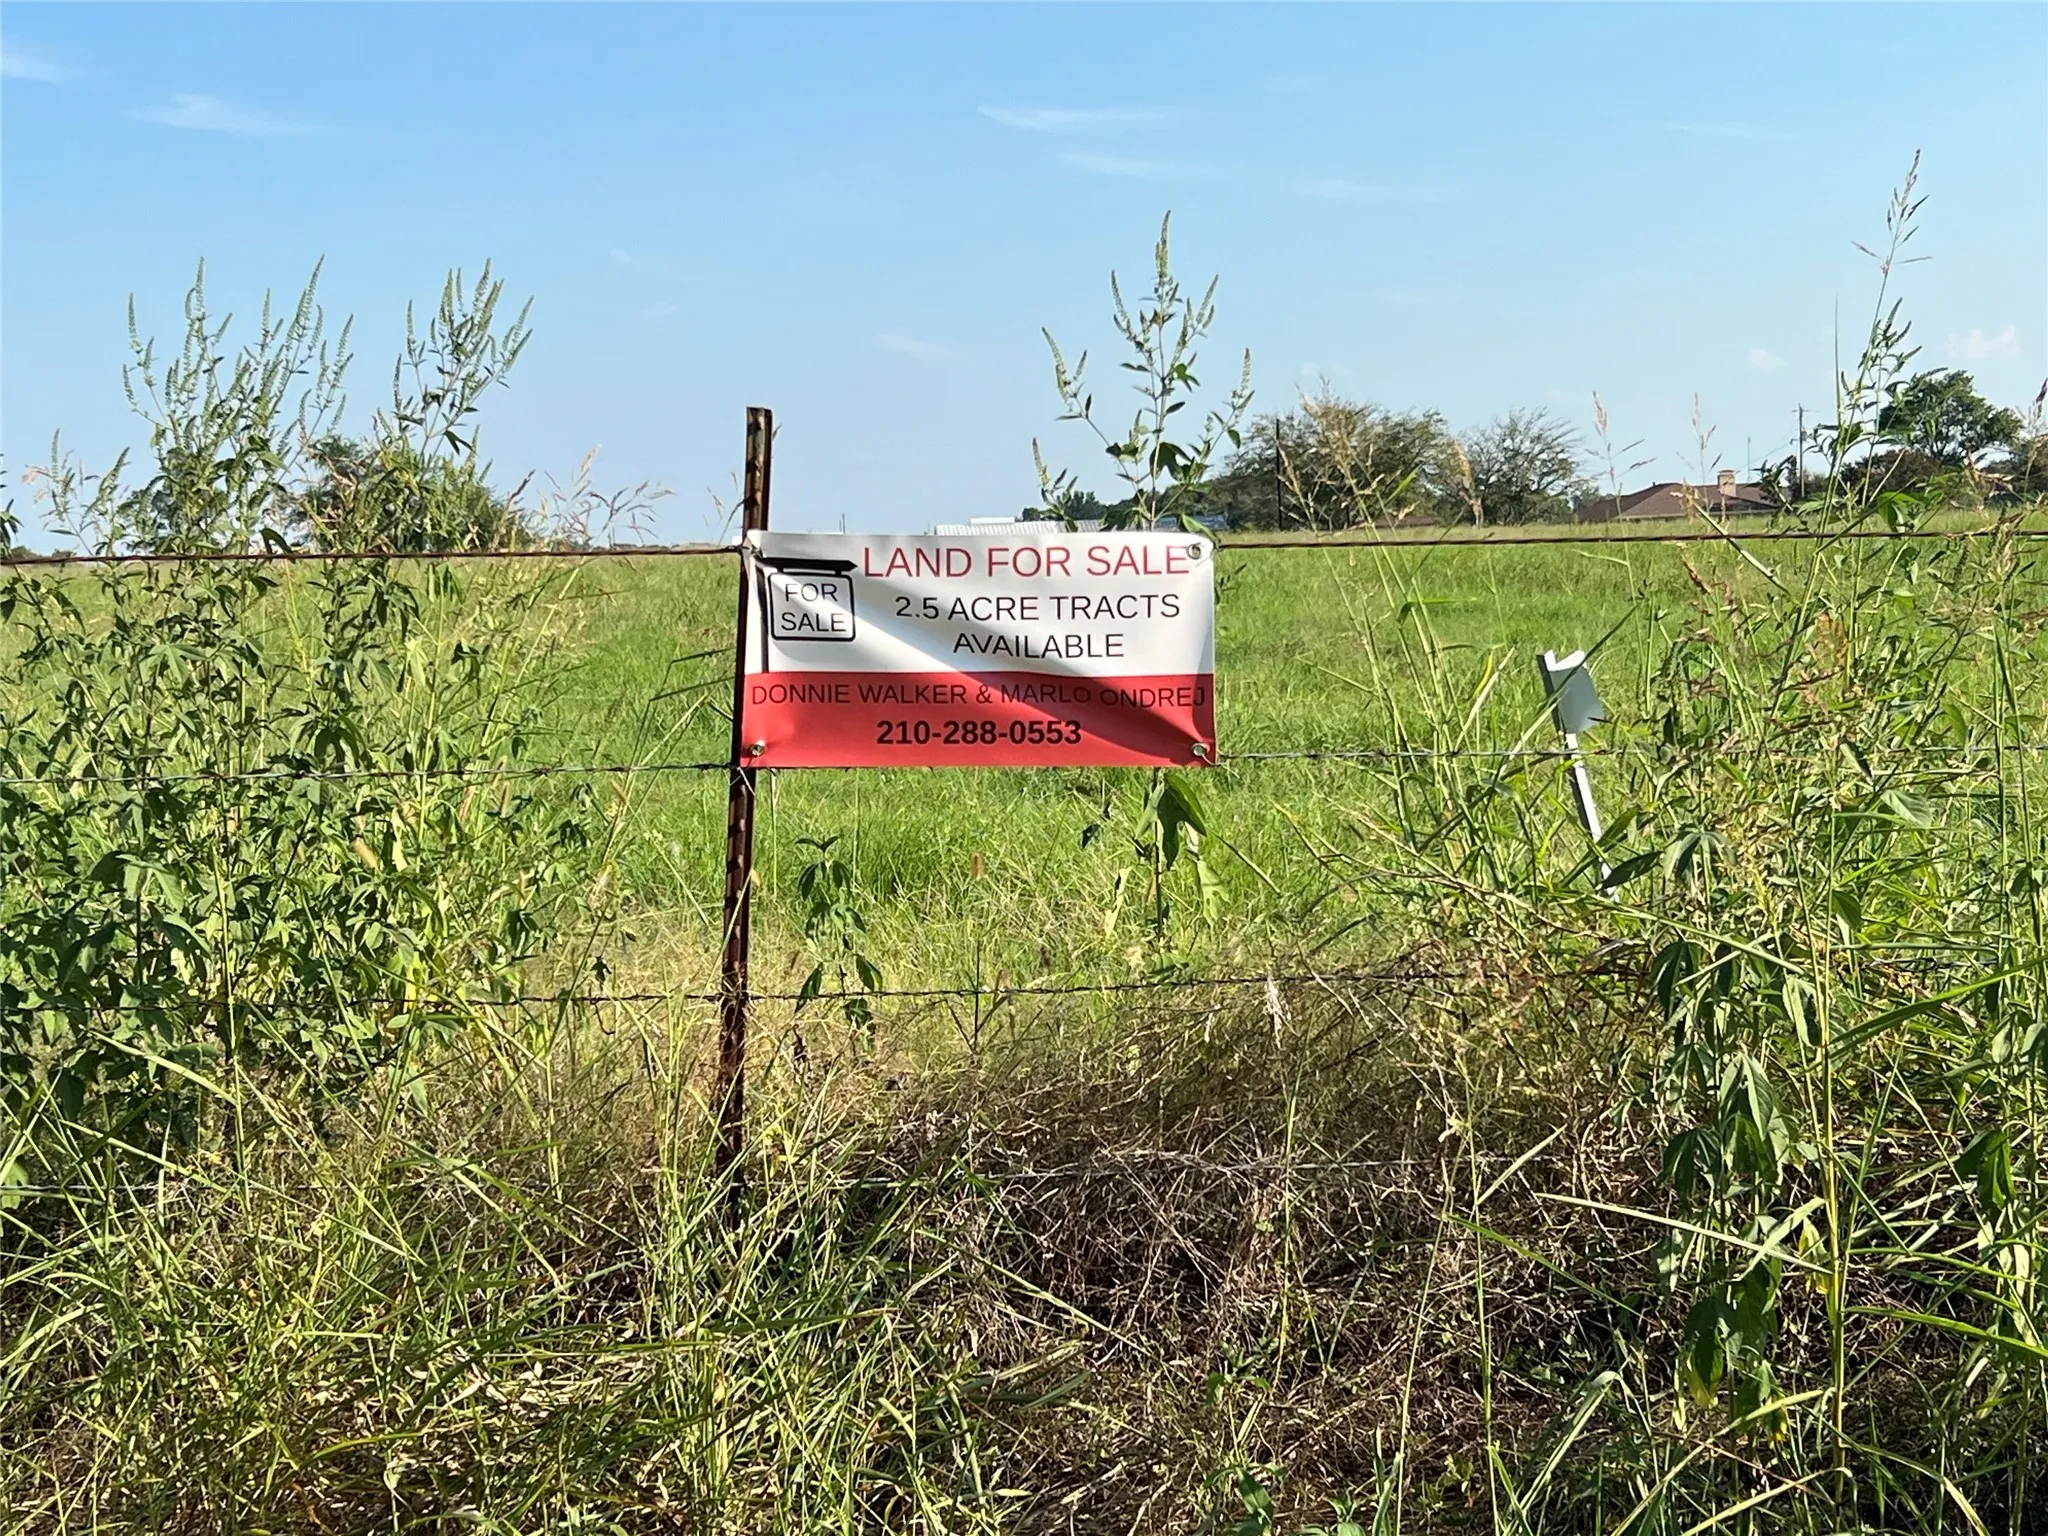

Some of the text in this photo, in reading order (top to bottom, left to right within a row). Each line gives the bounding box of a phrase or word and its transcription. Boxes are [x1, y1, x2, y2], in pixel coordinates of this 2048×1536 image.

[864, 546, 1189, 577] LAND FOR SALE
[785, 584, 837, 602] FOR
[896, 594, 1180, 621] 2.5 ACRE TRACTS
[781, 612, 846, 632] SALE
[953, 633, 1124, 658] AVAILABLE
[752, 684, 1205, 708] DONNIE WALKER & MARLO ONDREJ
[877, 720, 1082, 745] 210-288-0553
